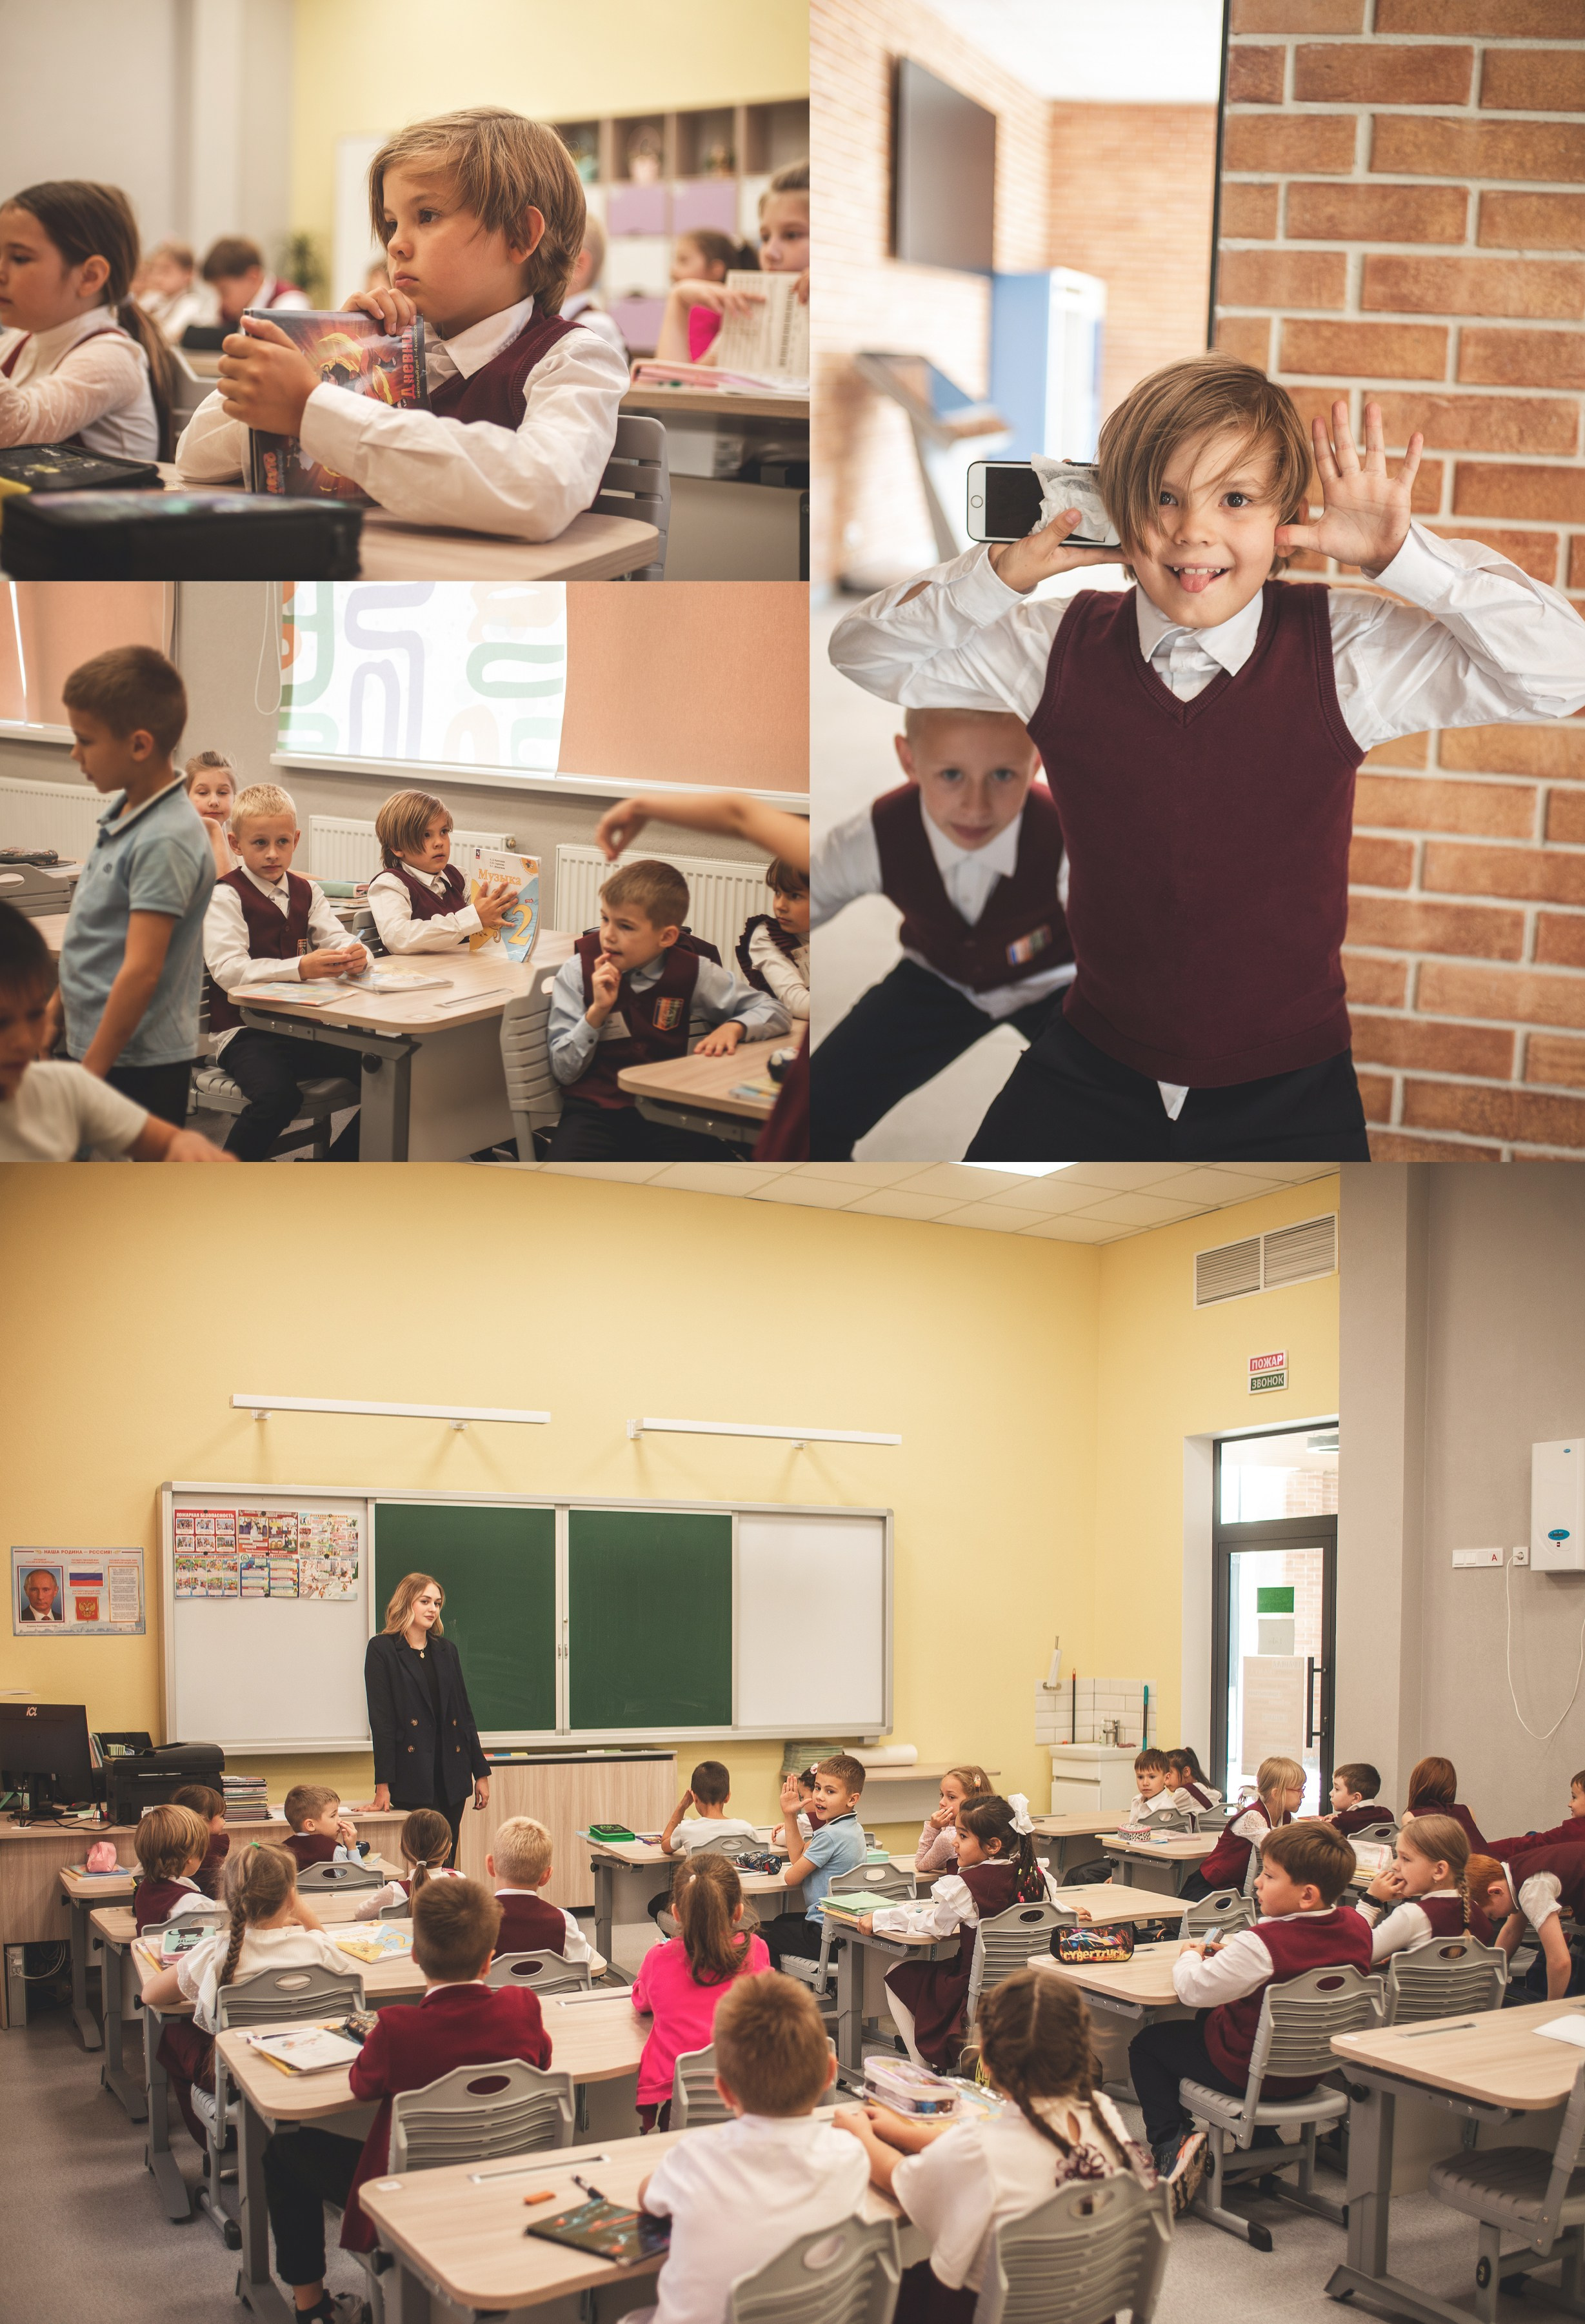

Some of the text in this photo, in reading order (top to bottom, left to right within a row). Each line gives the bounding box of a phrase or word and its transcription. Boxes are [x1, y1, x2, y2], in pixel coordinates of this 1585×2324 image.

[263, 452, 277, 494] ARUTO
[478, 868, 521, 885] Музыка
[508, 904, 532, 946] 2
[1251, 1354, 1282, 1370] ПОЖАР
[1251, 1374, 1284, 1389] ЗВОНОК
